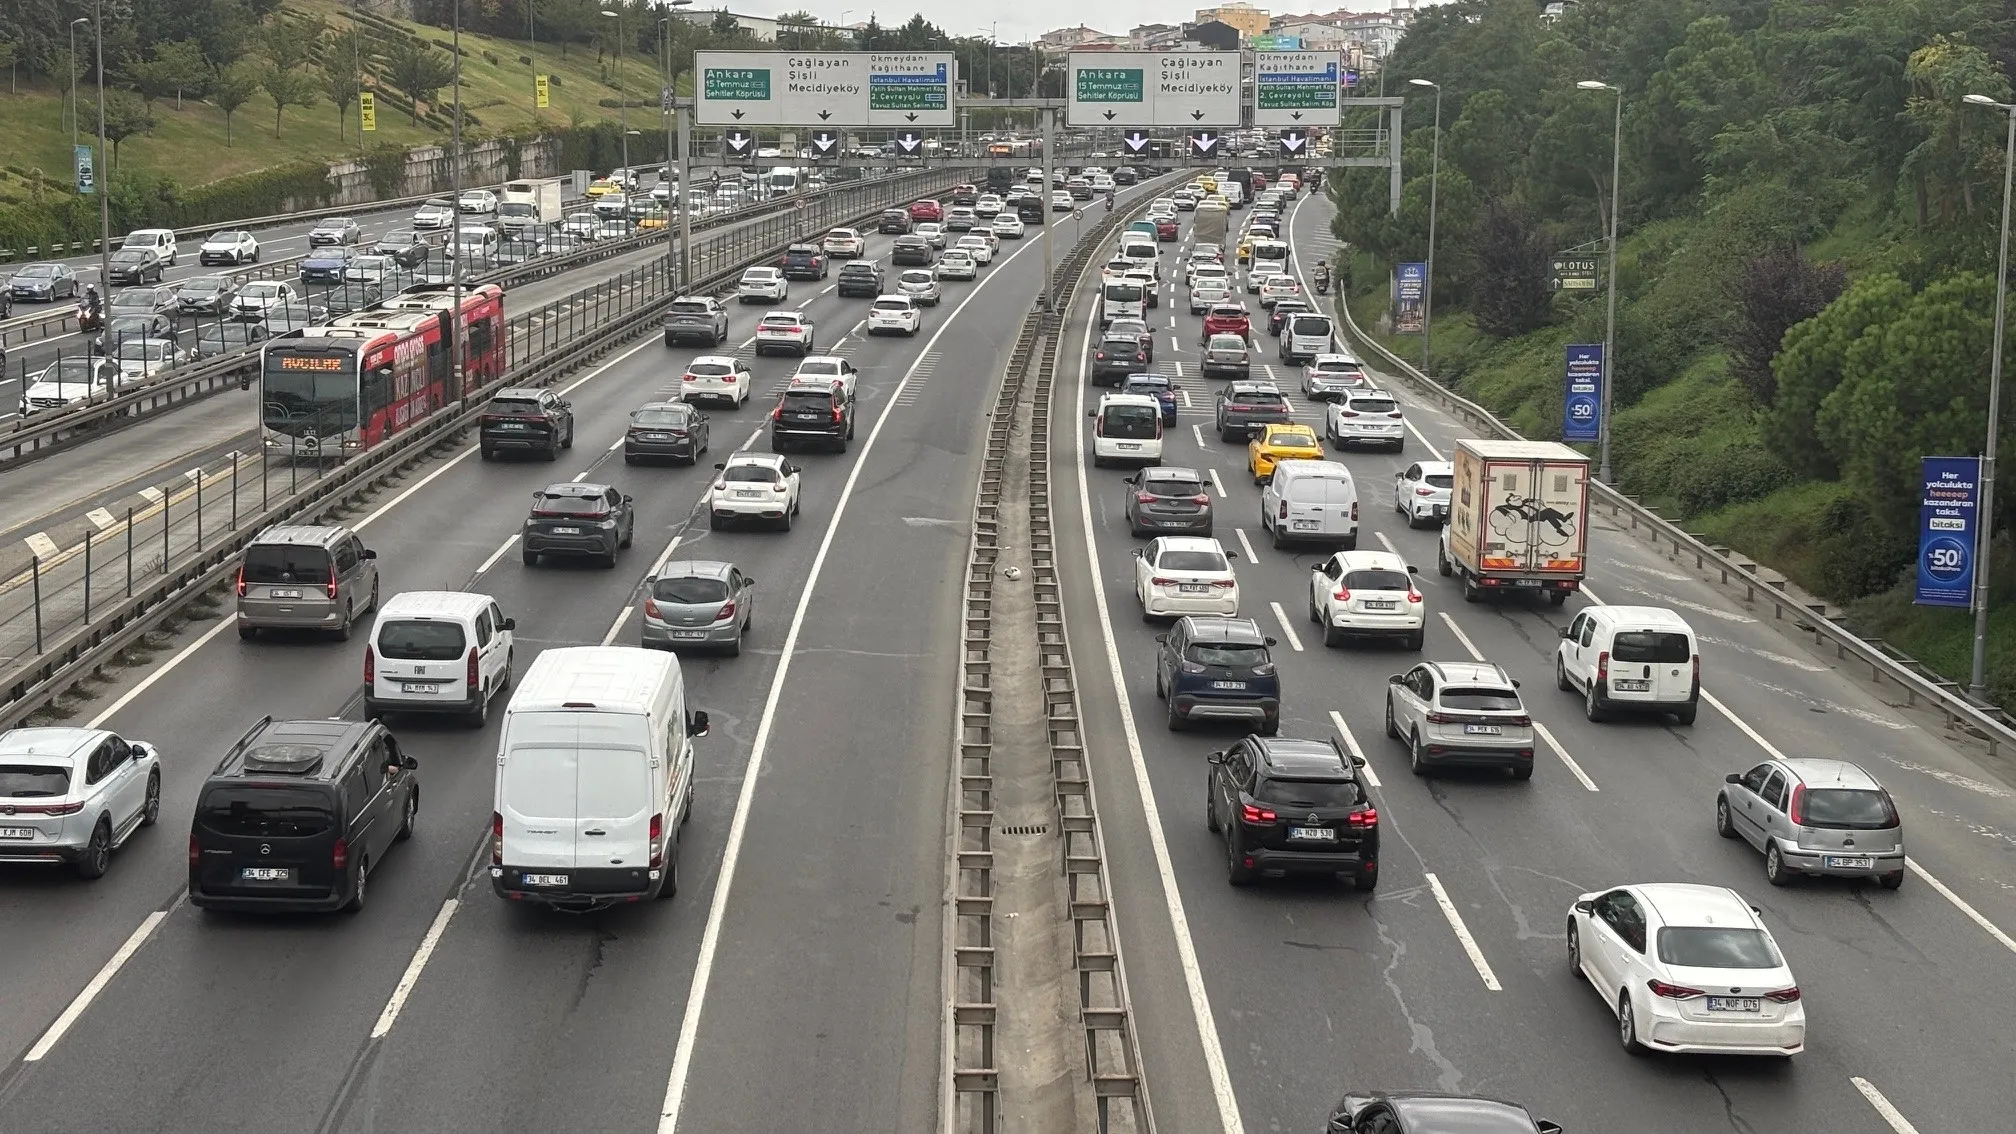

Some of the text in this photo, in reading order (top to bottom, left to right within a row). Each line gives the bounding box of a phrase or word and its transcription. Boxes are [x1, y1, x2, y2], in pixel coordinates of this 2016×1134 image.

[871, 55, 928, 63] Okmeydanı
[1260, 54, 1317, 62] Okmeydanı
[788, 58, 849, 69] Çağlayan
[1161, 58, 1223, 69] Çağlayan
[706, 70, 754, 79] Ankara
[1079, 70, 1126, 79] Ankara
[1161, 71, 1190, 81] Şişli
[788, 83, 860, 94] Mecidiyeköy
[1078, 82, 1122, 90] 15 Temmuz
[1161, 83, 1233, 94] Mecidiyeköy
[706, 89, 766, 98] Şehitler Köprüsü
[1078, 91, 1139, 100] Şehitler Köprüsü
[1563, 261, 1595, 270] LOTUS
[1926, 480, 1973, 489] yolculukta
[1923, 498, 1974, 507] kazandıran
[1932, 520, 1963, 529] bitaksi
[1854, 859, 1867, 867] 353
[248, 869, 255, 877] 34
[527, 875, 536, 884] 34
[555, 876, 567, 885] 461
[1712, 998, 1758, 1009] 34 NOF 076
